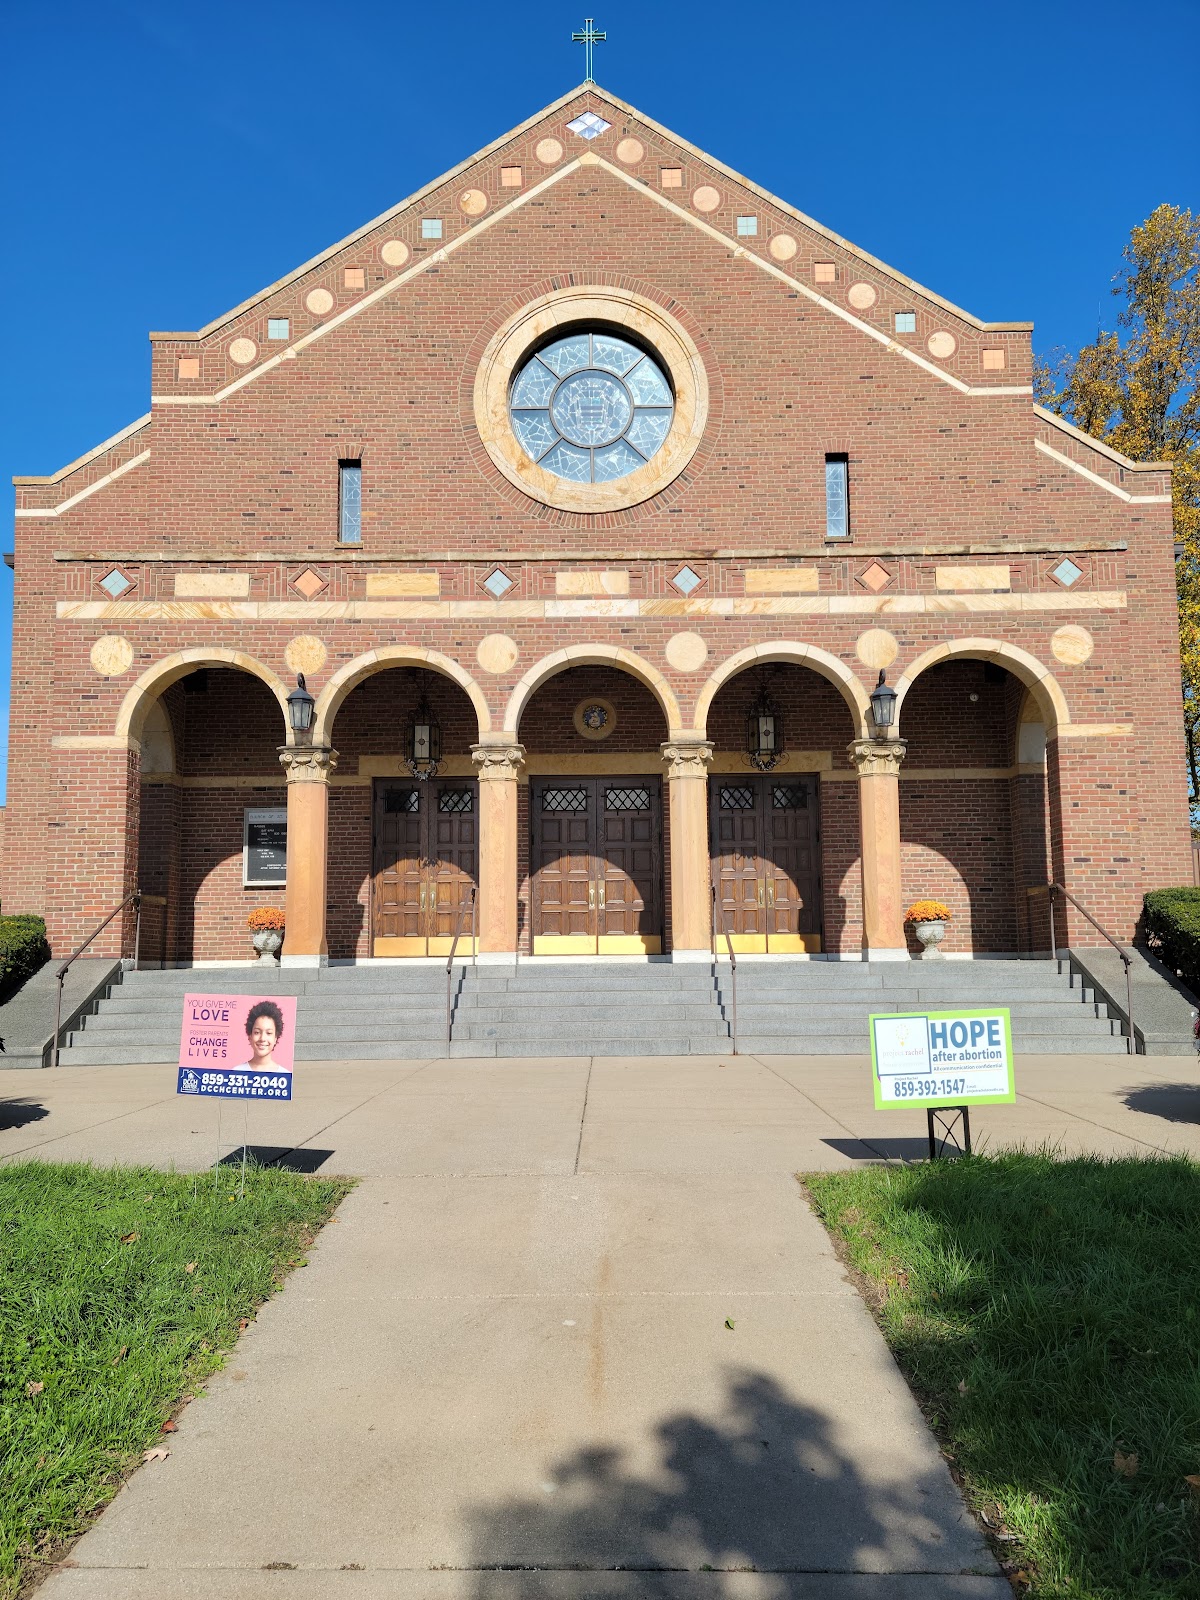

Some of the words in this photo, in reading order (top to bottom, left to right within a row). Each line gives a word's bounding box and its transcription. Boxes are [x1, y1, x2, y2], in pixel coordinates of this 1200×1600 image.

[187, 999, 204, 1008] YOU
[206, 1000, 224, 1009] GIVE
[225, 1001, 237, 1009] ME
[192, 1009, 230, 1022] LOVE
[930, 1019, 1001, 1049] HOPE
[189, 1037, 228, 1047] CHANGE
[188, 1048, 227, 1058] LIVES
[882, 1049, 904, 1059] project
[905, 1047, 924, 1056] rachel
[932, 1050, 956, 1062] after
[959, 1048, 1002, 1061] abortion
[201, 1073, 288, 1089] 859-331-2040
[894, 1078, 966, 1097] 859-392-1547
[201, 1084, 288, 1097] DCCHCENTER.ORG
